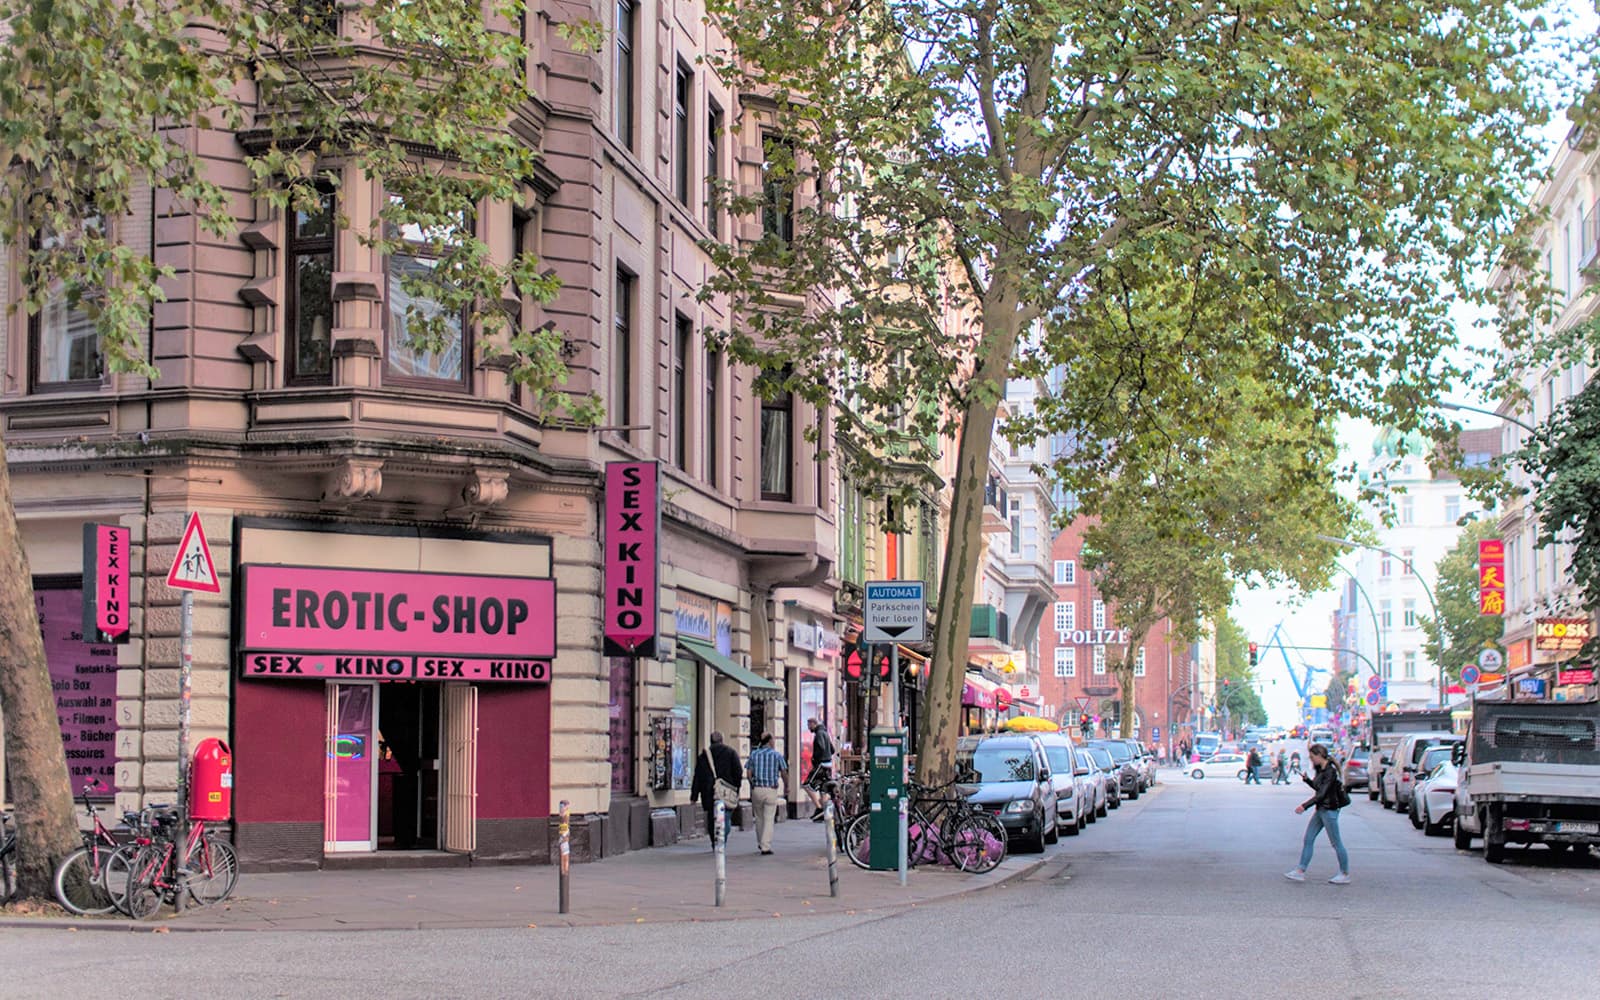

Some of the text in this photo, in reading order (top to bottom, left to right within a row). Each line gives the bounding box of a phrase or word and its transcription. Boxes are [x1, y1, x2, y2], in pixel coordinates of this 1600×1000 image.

[616, 467, 643, 629] SEX KINO
[106, 530, 119, 625] SEX KINO
[871, 588, 917, 598] AUTOMAT
[1481, 566, 1504, 614] 天府
[272, 588, 529, 635] EROTIC-SHOP
[871, 602, 920, 611] Parkschein
[872, 614, 890, 623] hier
[1537, 623, 1589, 637] KIOSK
[1060, 630, 1128, 644] POLIZE
[75, 664, 104, 674] Kontakt
[254, 656, 404, 675] SEX KINO
[424, 660, 464, 677] SEX
[490, 662, 545, 679] KINO
[73, 680, 91, 690] Box
[1519, 680, 1539, 692] HSV
[57, 696, 112, 707] Auswahl an
[72, 713, 105, 724] Filmen
[80, 730, 115, 742] Bücher
[65, 747, 104, 759] essoires
